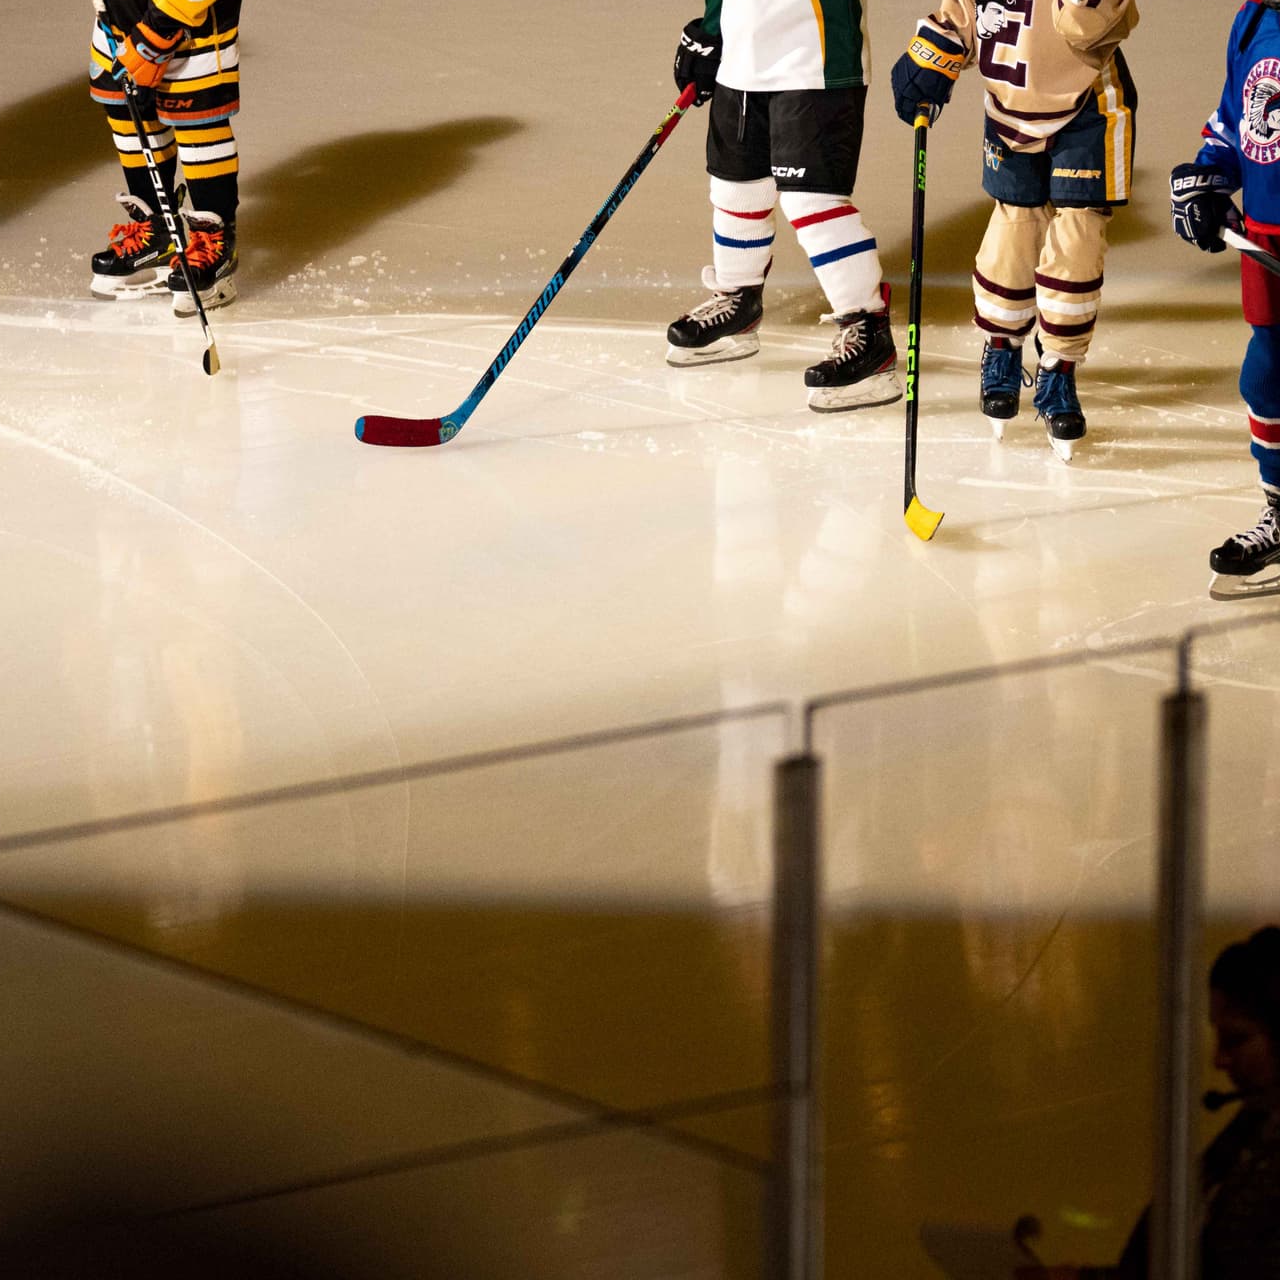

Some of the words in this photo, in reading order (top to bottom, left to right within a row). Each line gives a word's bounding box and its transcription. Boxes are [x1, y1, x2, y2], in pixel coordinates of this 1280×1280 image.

[680, 31, 715, 57] CM
[910, 40, 961, 74] BAUE
[771, 166, 807, 179] CCM
[491, 271, 565, 380] WARRIOR
[906, 322, 917, 401] CCM
